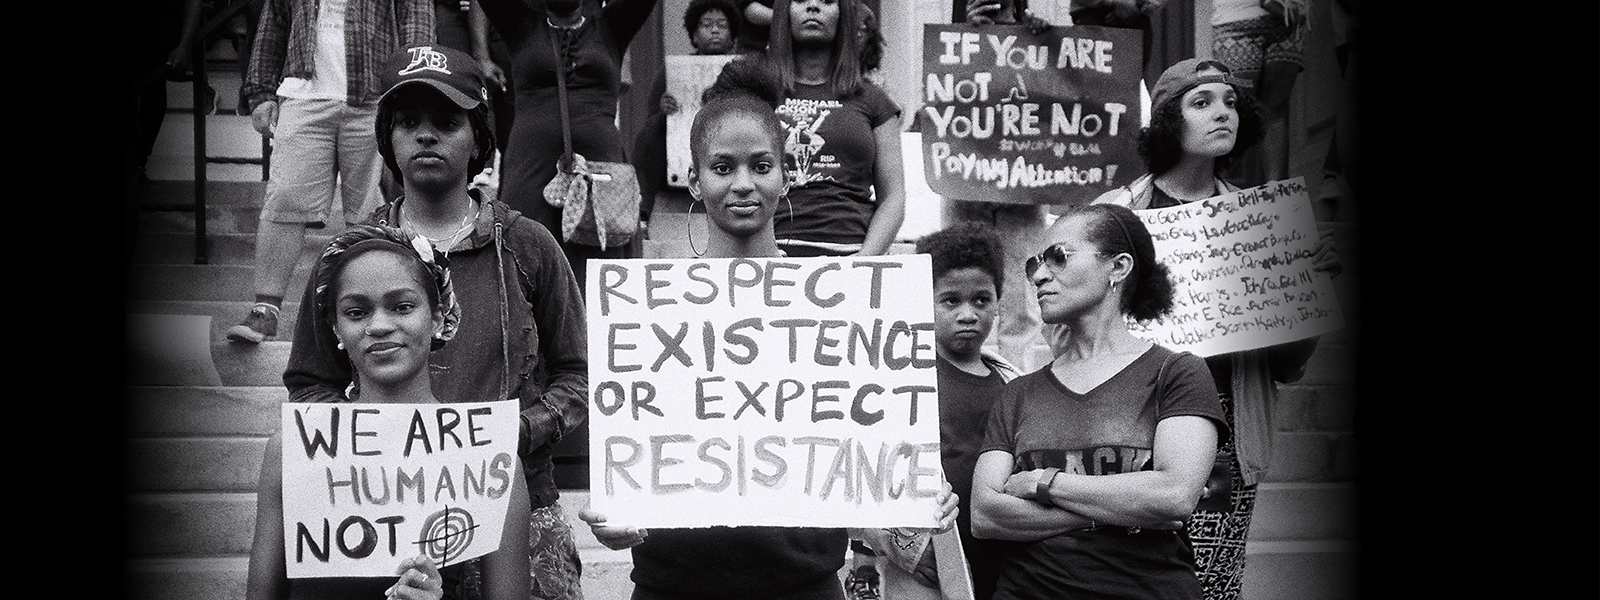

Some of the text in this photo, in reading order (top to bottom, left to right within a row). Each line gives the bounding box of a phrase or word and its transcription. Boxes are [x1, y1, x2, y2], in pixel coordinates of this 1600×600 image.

[939, 31, 980, 65] IF
[1057, 37, 1113, 73] ARE
[774, 104, 817, 116] ACKSON
[785, 98, 843, 109] MICHAEL
[927, 72, 992, 103] NOT
[1051, 103, 1127, 136] NOT
[599, 258, 903, 316] RESPECT
[607, 318, 936, 373] EXISTENCE
[594, 376, 936, 426] OR EXPECT
[295, 407, 492, 460] WE ARE
[326, 453, 512, 507] HUMANS
[604, 434, 941, 505] RESISTANCE
[296, 516, 405, 563] NOT
